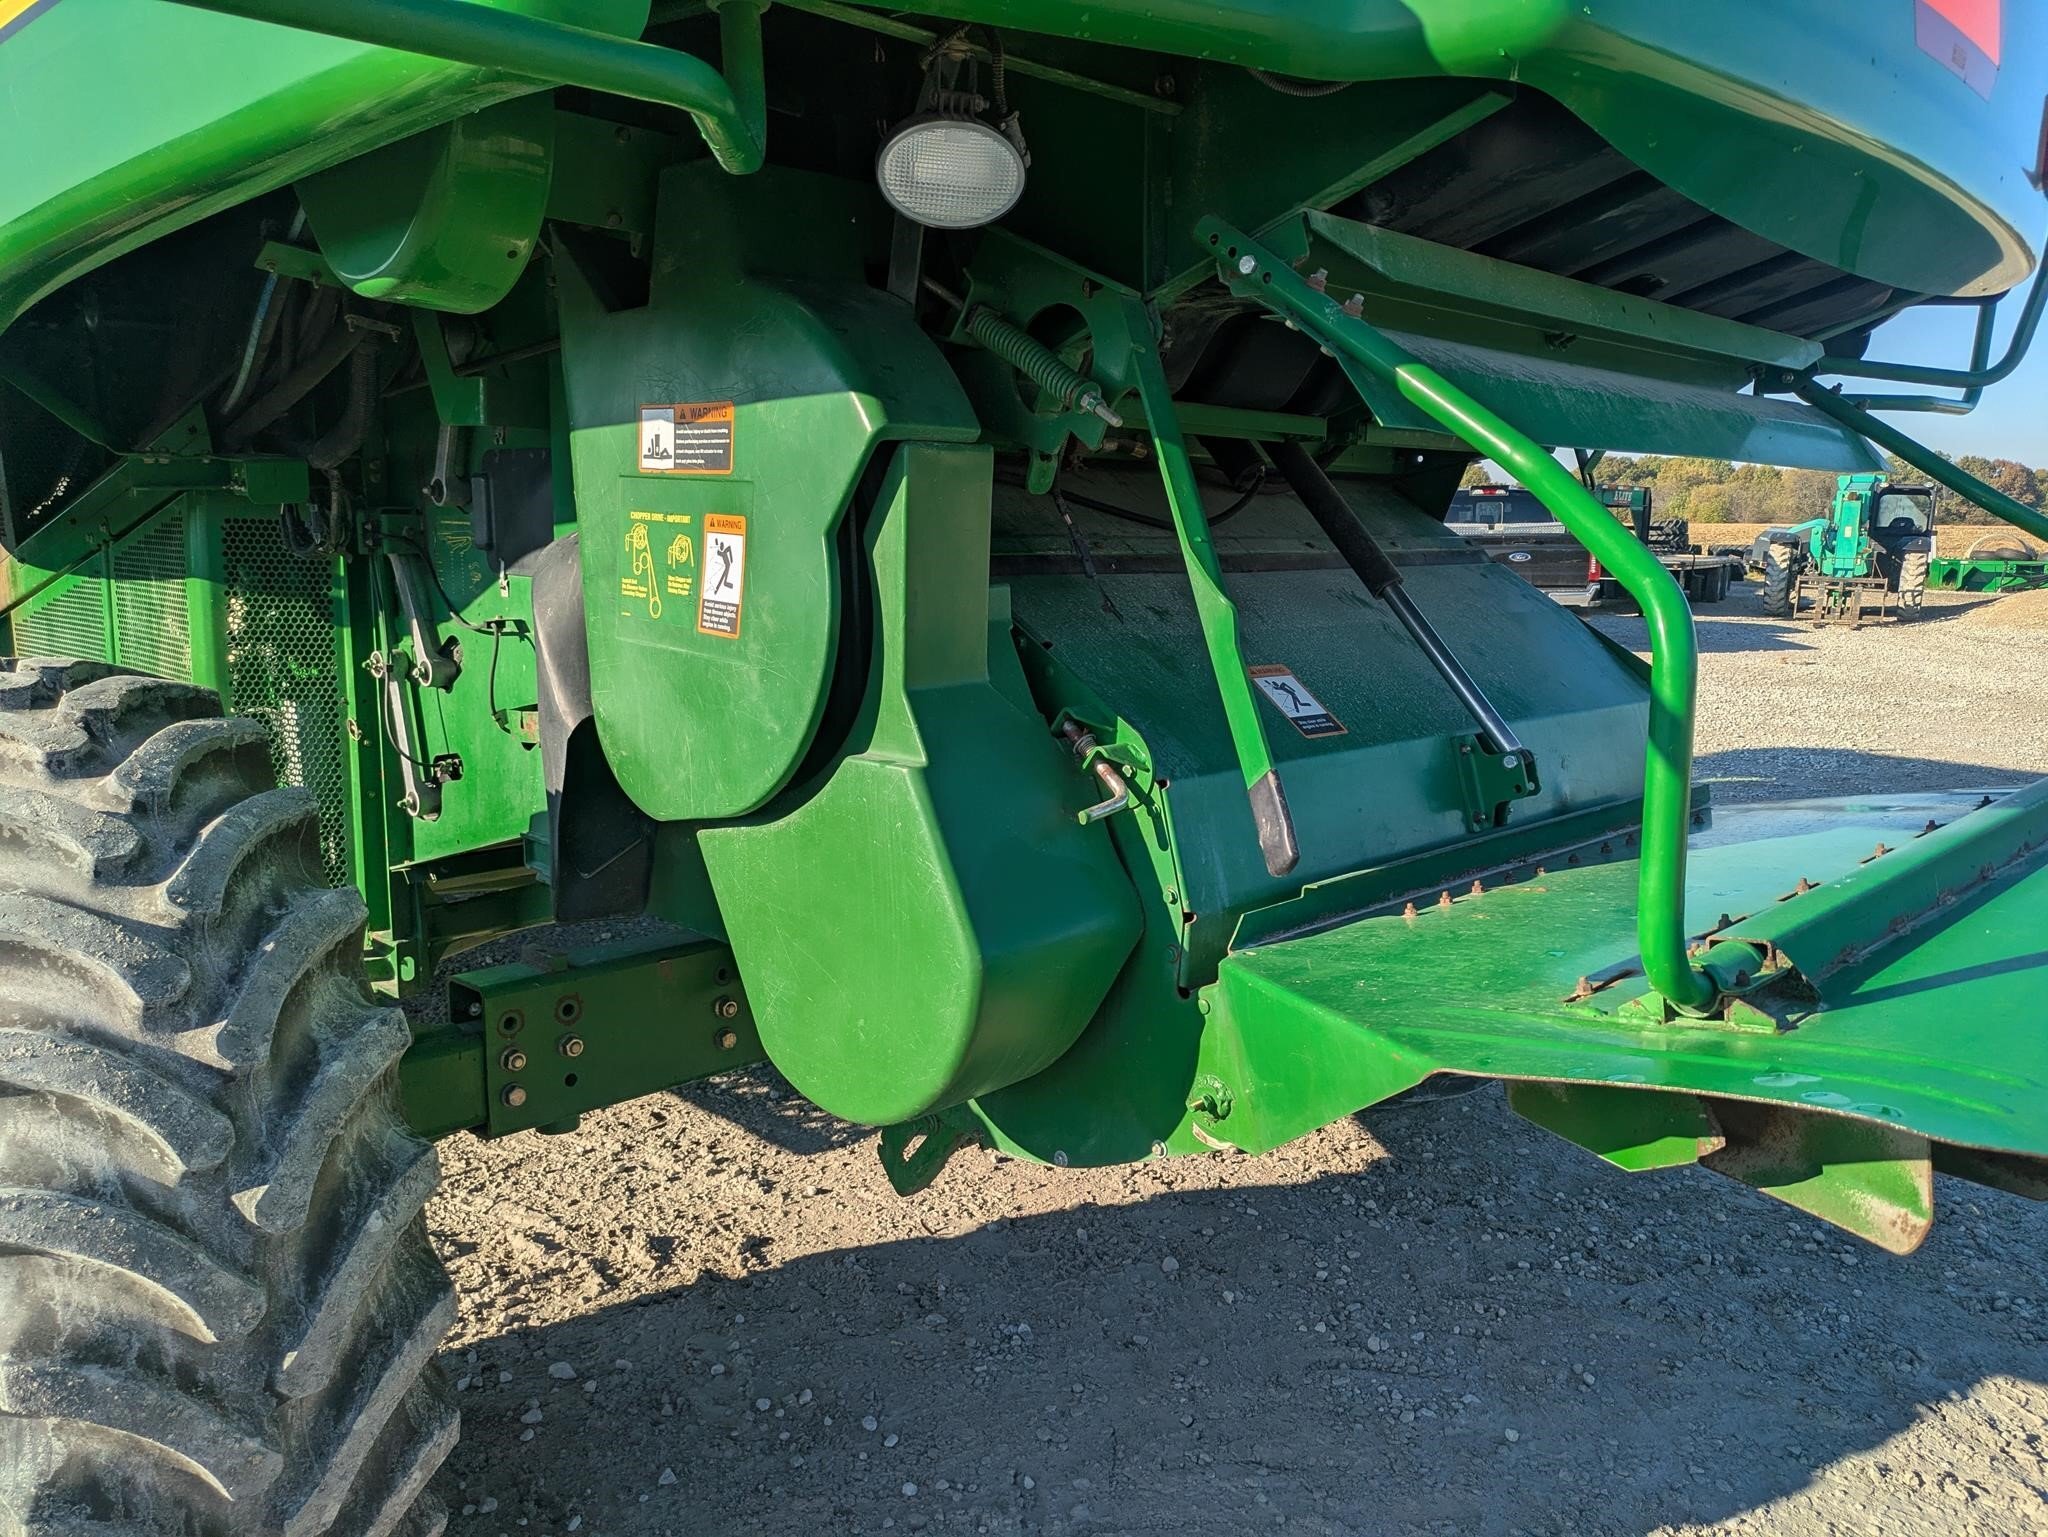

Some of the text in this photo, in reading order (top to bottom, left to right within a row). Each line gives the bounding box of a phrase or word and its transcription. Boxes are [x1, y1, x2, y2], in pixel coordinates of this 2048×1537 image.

[690, 406, 727, 419] WARNING
[630, 511, 650, 521] CHOPPER
[716, 519, 742, 530] WARNING
